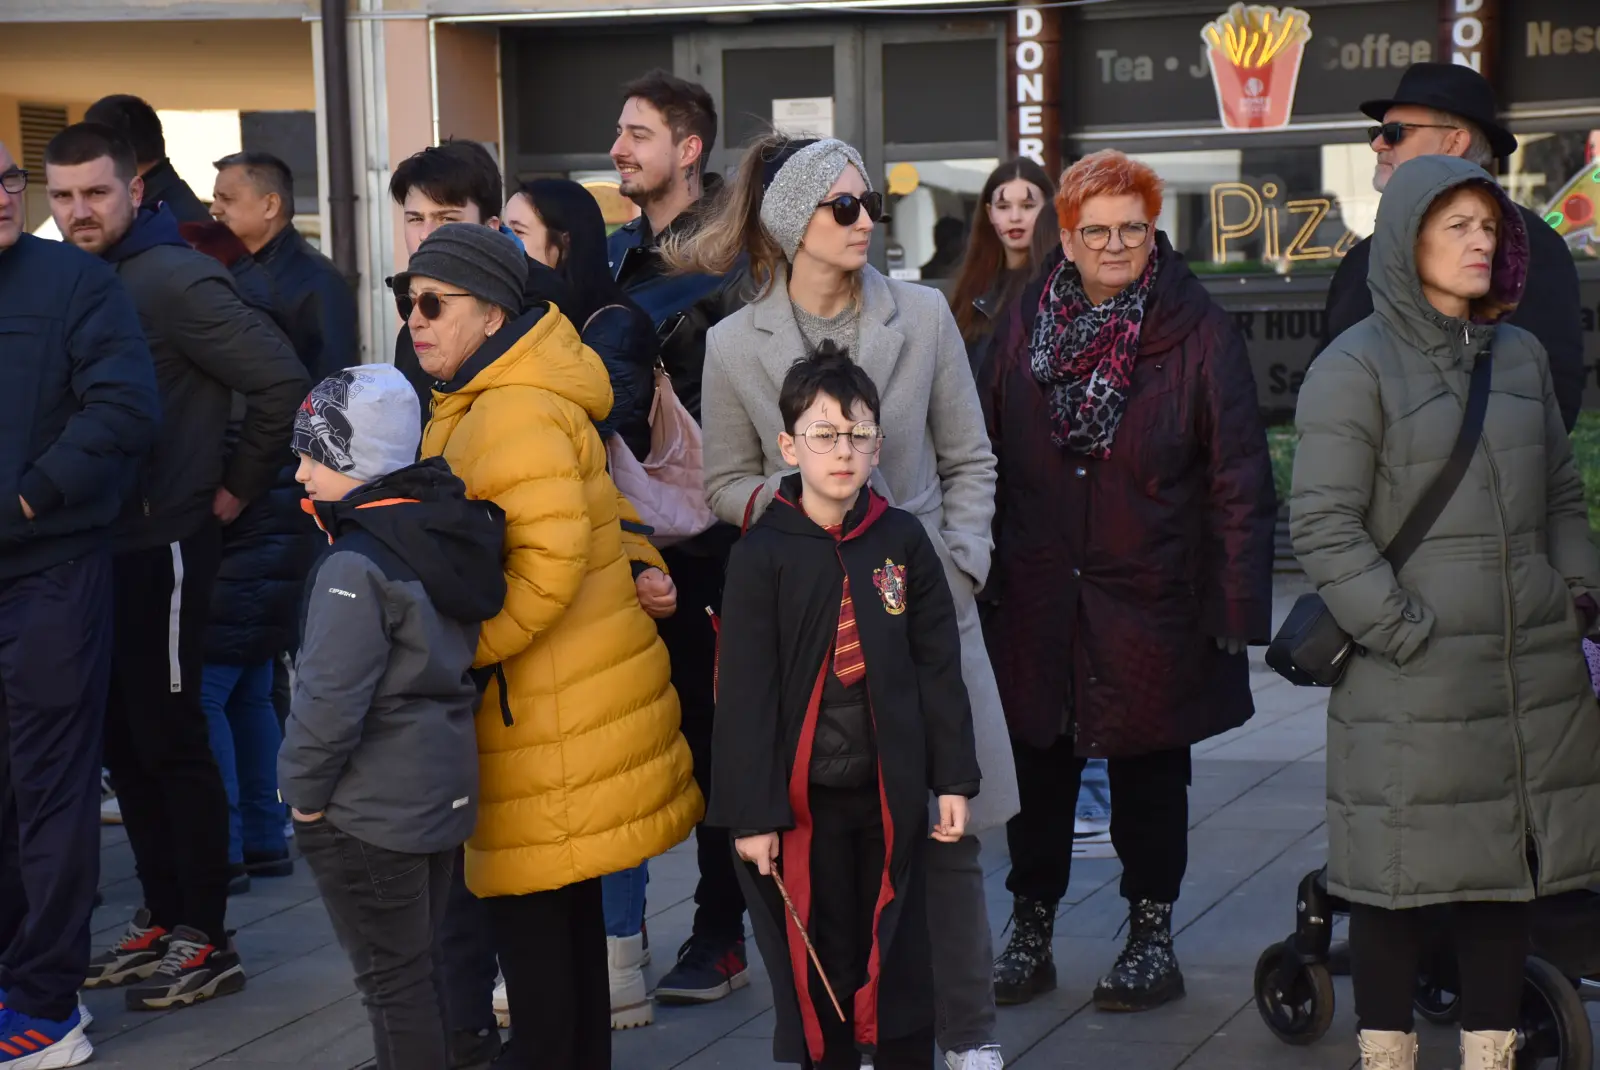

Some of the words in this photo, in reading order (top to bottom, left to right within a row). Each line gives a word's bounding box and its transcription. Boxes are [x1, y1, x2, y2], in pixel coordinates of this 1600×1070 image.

[1526, 21, 1600, 57] Nes
[1096, 49, 1153, 83] Tea
[1016, 8, 1046, 167] DONER
